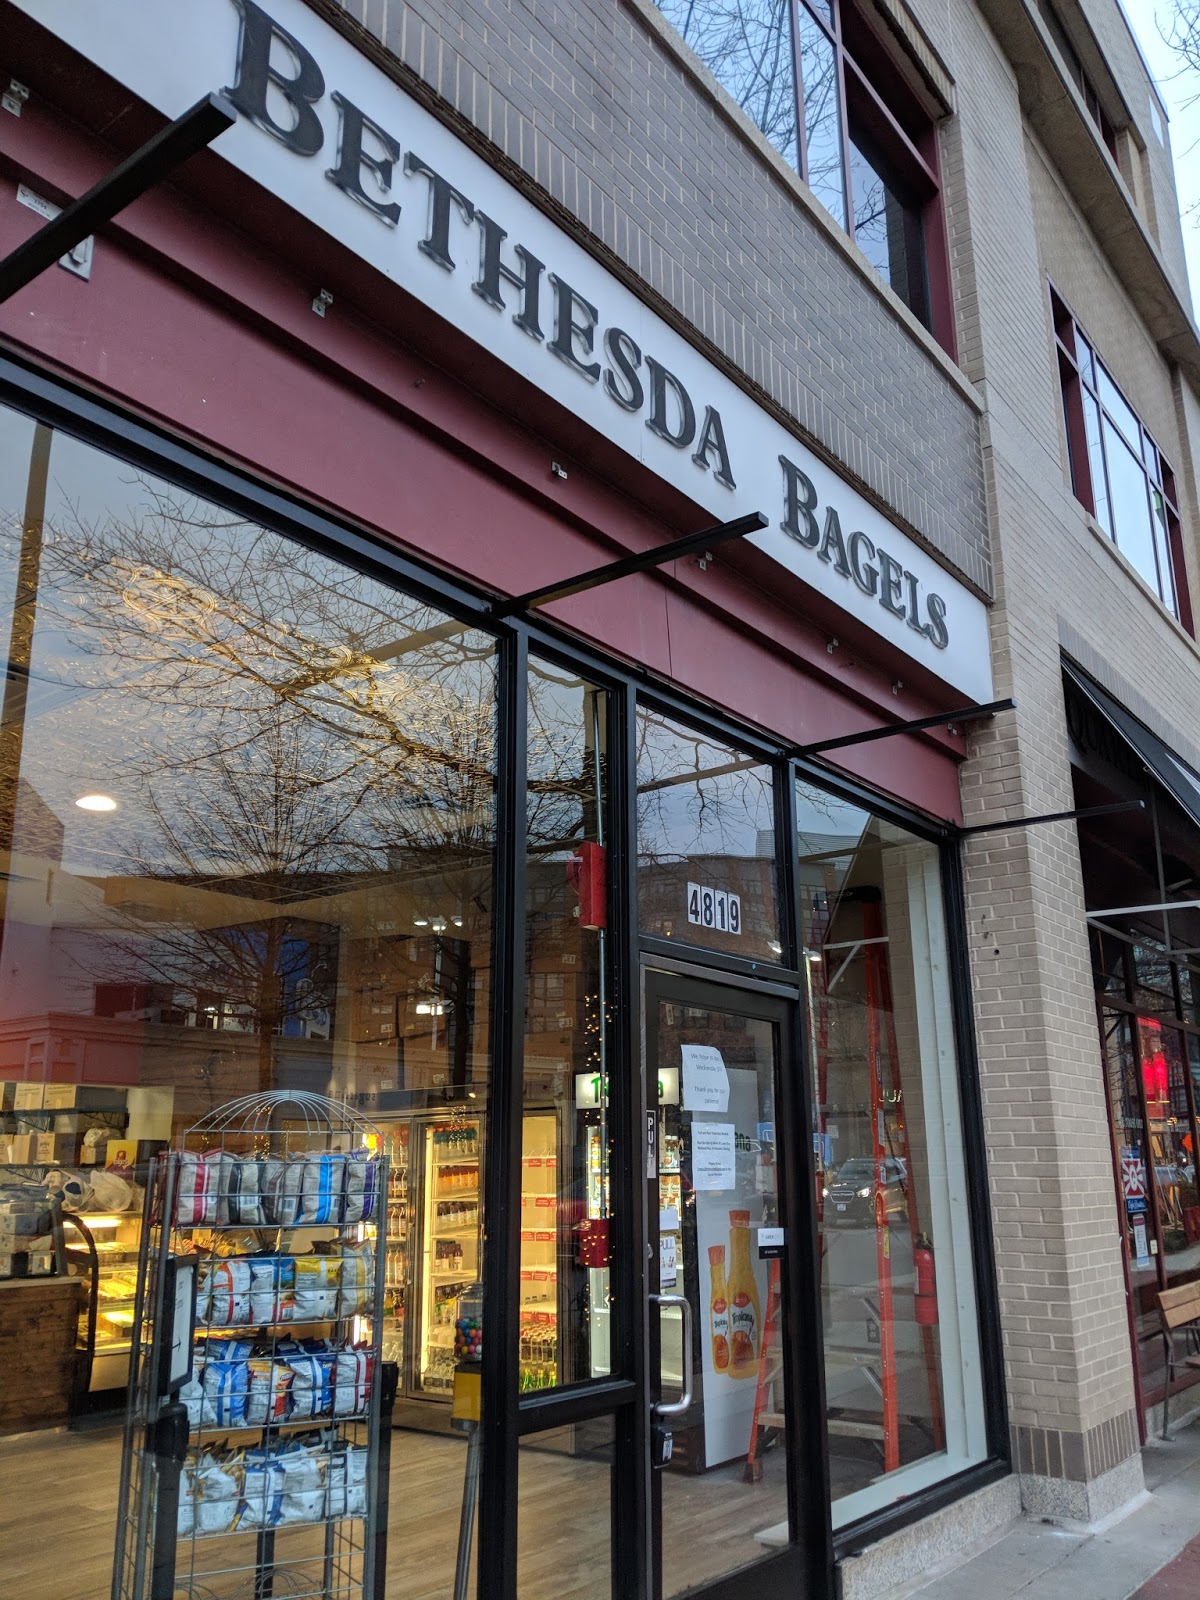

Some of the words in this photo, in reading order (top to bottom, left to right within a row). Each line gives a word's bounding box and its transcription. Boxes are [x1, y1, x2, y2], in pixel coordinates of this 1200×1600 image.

[219, 0, 736, 491] BETHESDA
[777, 454, 949, 650] BAGELS
[690, 889, 739, 932] 4819
